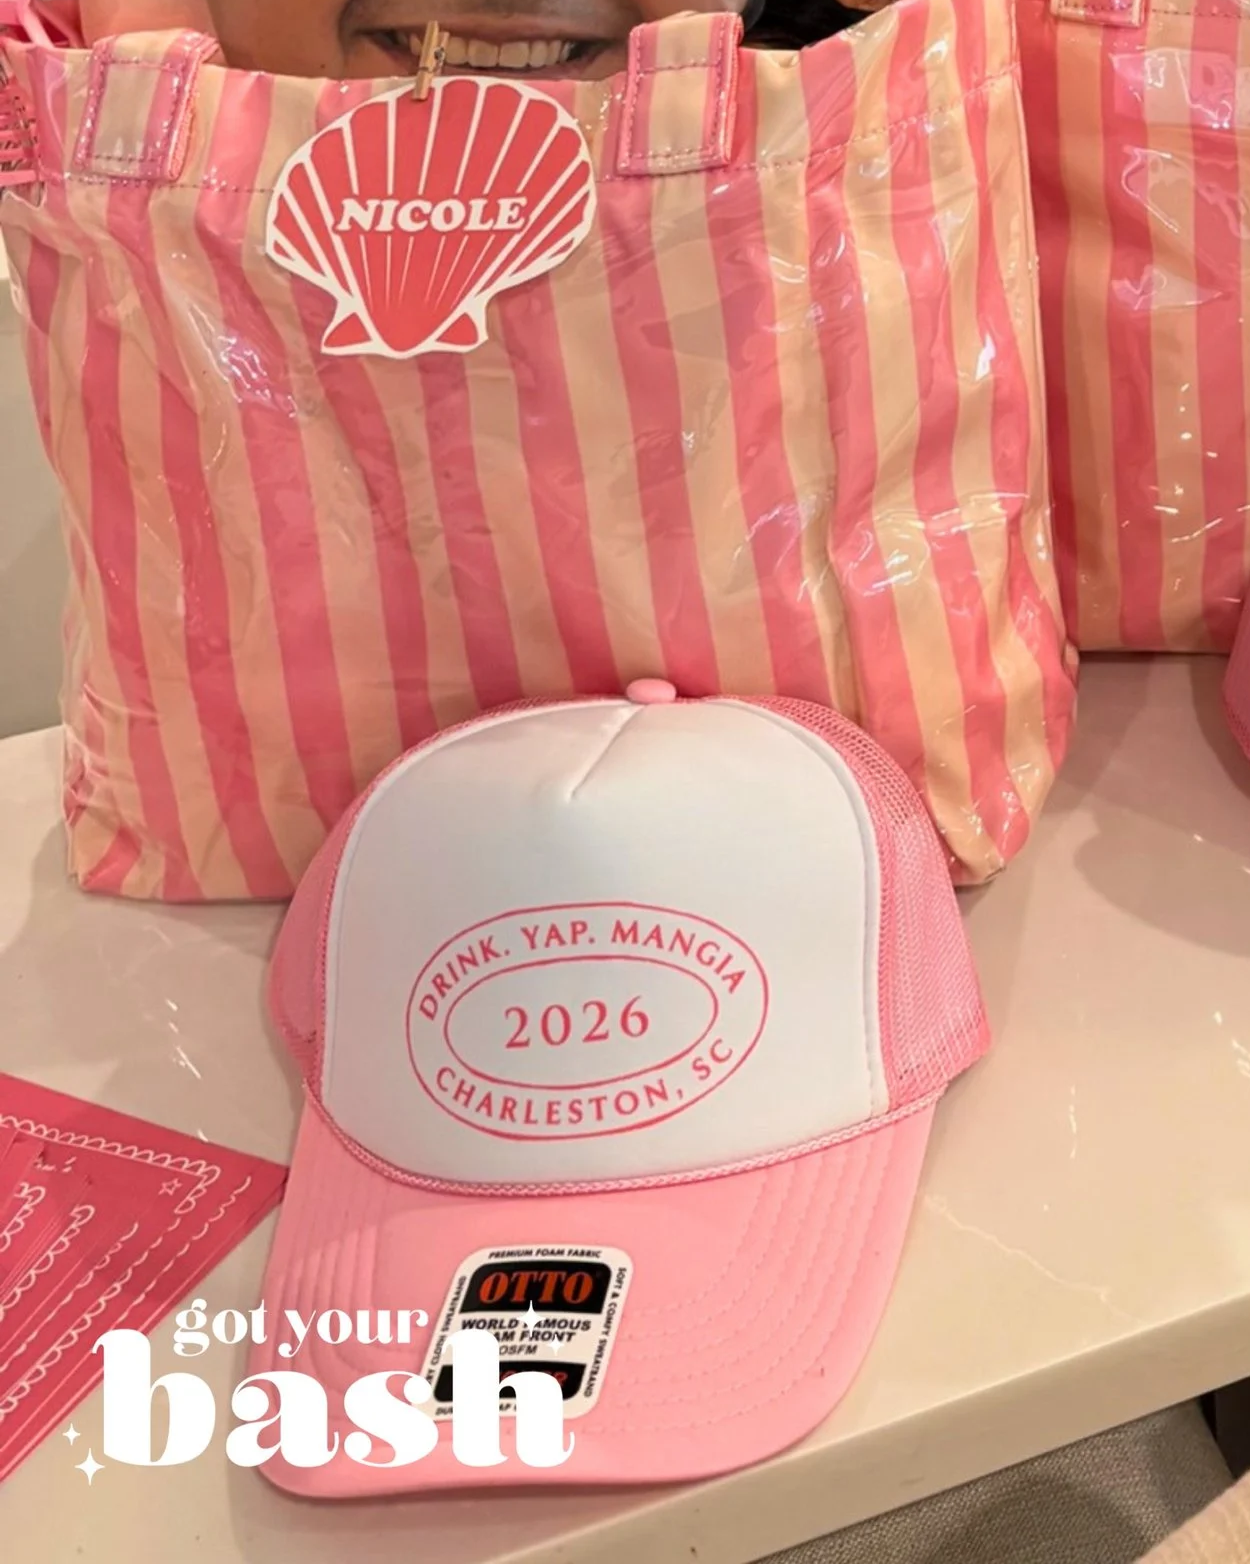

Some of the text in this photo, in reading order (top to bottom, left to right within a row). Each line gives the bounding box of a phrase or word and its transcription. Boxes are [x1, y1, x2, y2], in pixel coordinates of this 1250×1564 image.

[335, 197, 528, 232] NICOLE
[419, 920, 746, 1022] DRINK. YAP. MANGIA
[505, 995, 650, 1049] 2026
[436, 1039, 733, 1126] CHARLESTON, SC
[488, 1248, 602, 1259] PREMIUM FOAM FABRIC
[479, 1271, 593, 1304] OTTO
[613, 1267, 627, 1289] SOFT
[461, 1318, 591, 1331] WORLD AMOUS
[602, 1302, 617, 1337] COMFY
[584, 1338, 607, 1398] SWEATBAND
